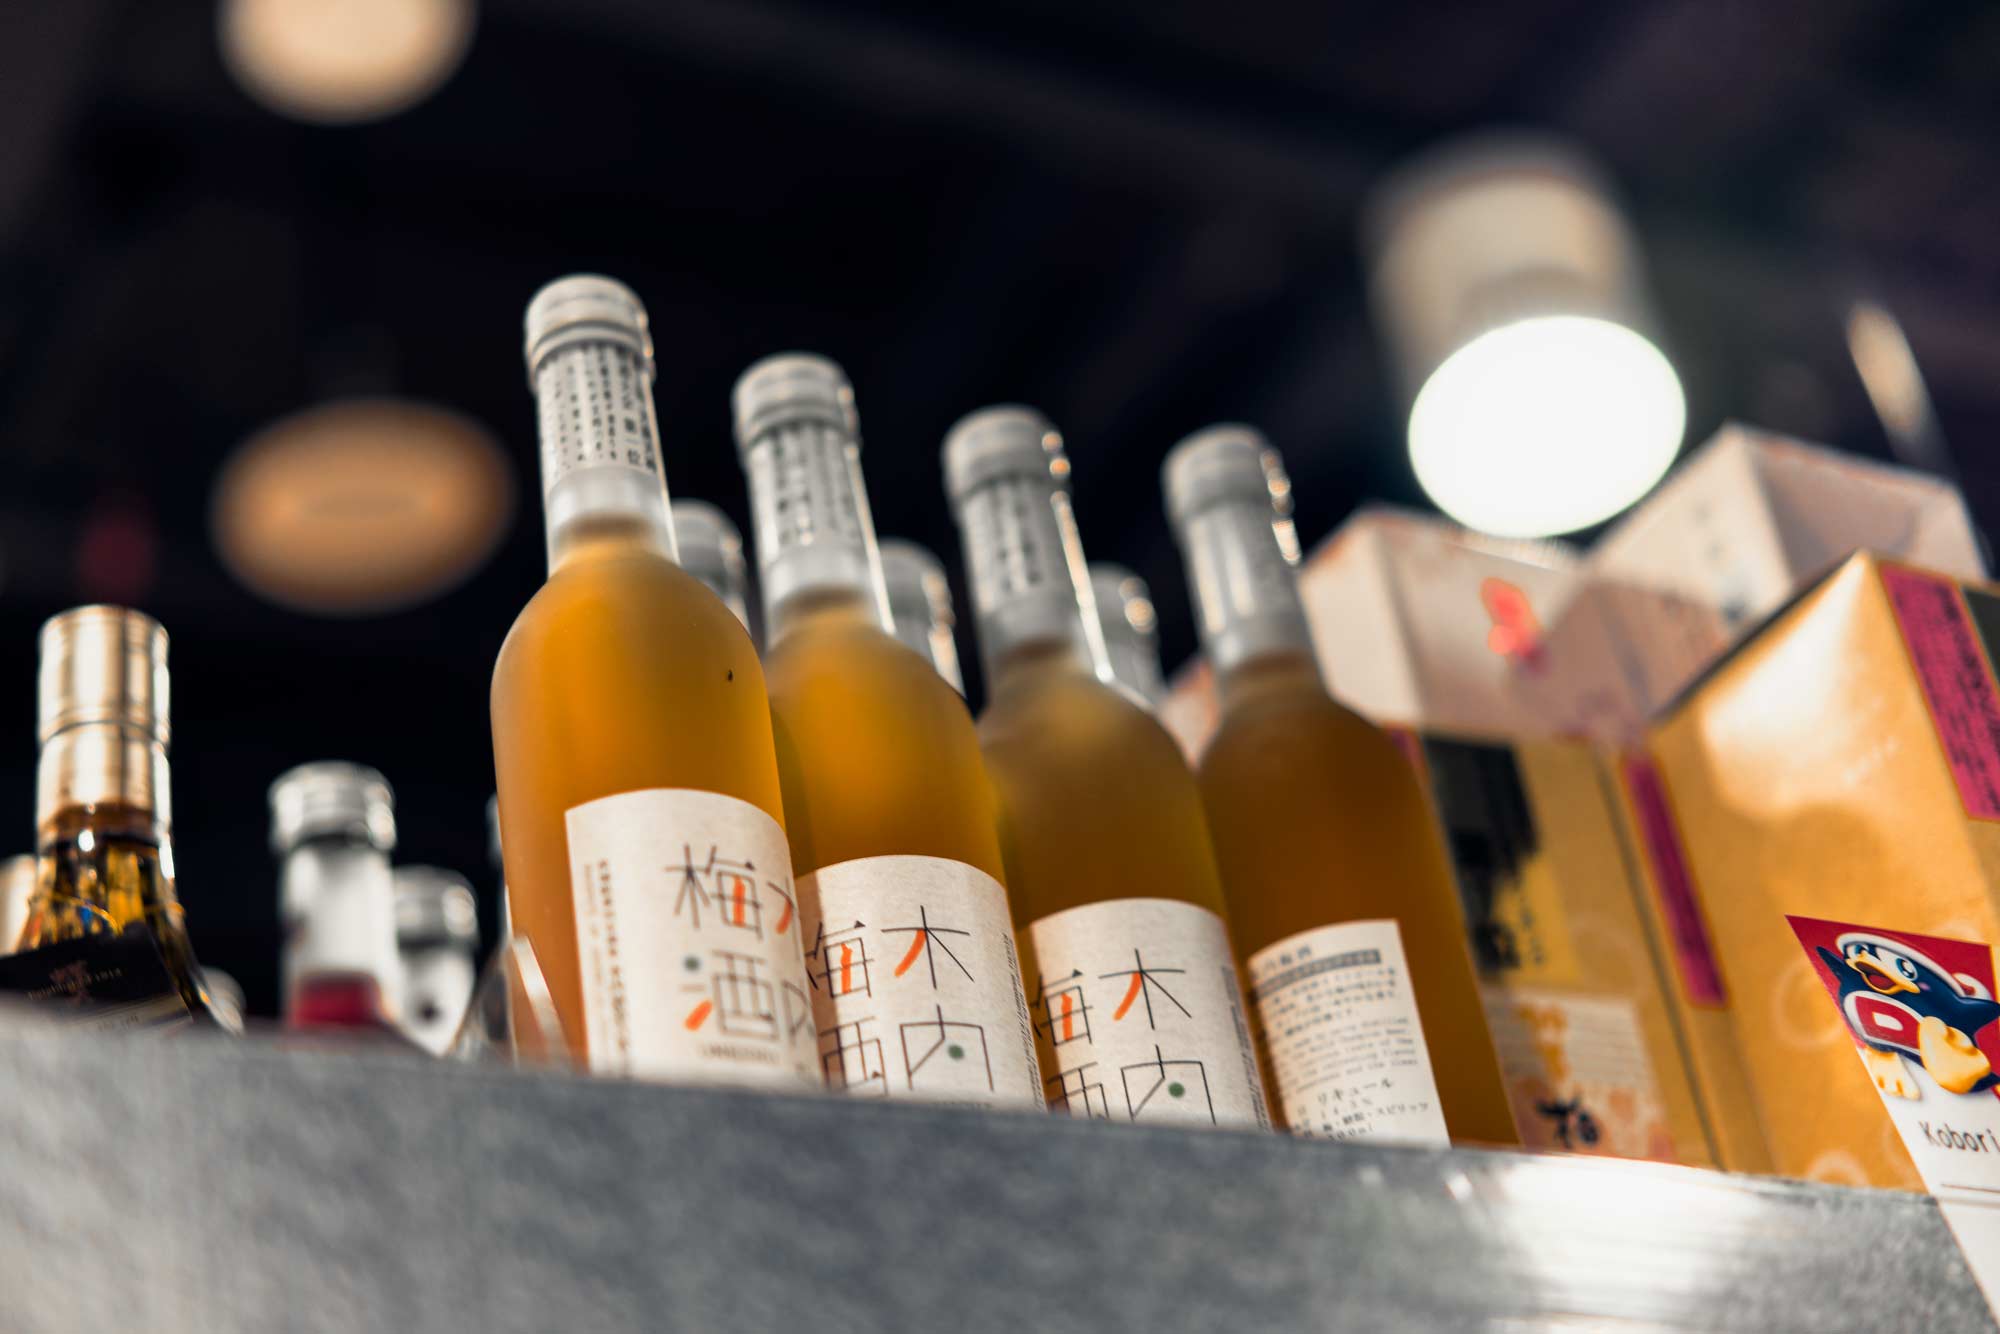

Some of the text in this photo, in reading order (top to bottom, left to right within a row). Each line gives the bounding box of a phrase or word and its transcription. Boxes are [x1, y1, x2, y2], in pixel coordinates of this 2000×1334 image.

[880, 904, 996, 1093] 木内
[1097, 947, 1217, 1126] 木内
[1917, 1120, 2000, 1153] Kobori
